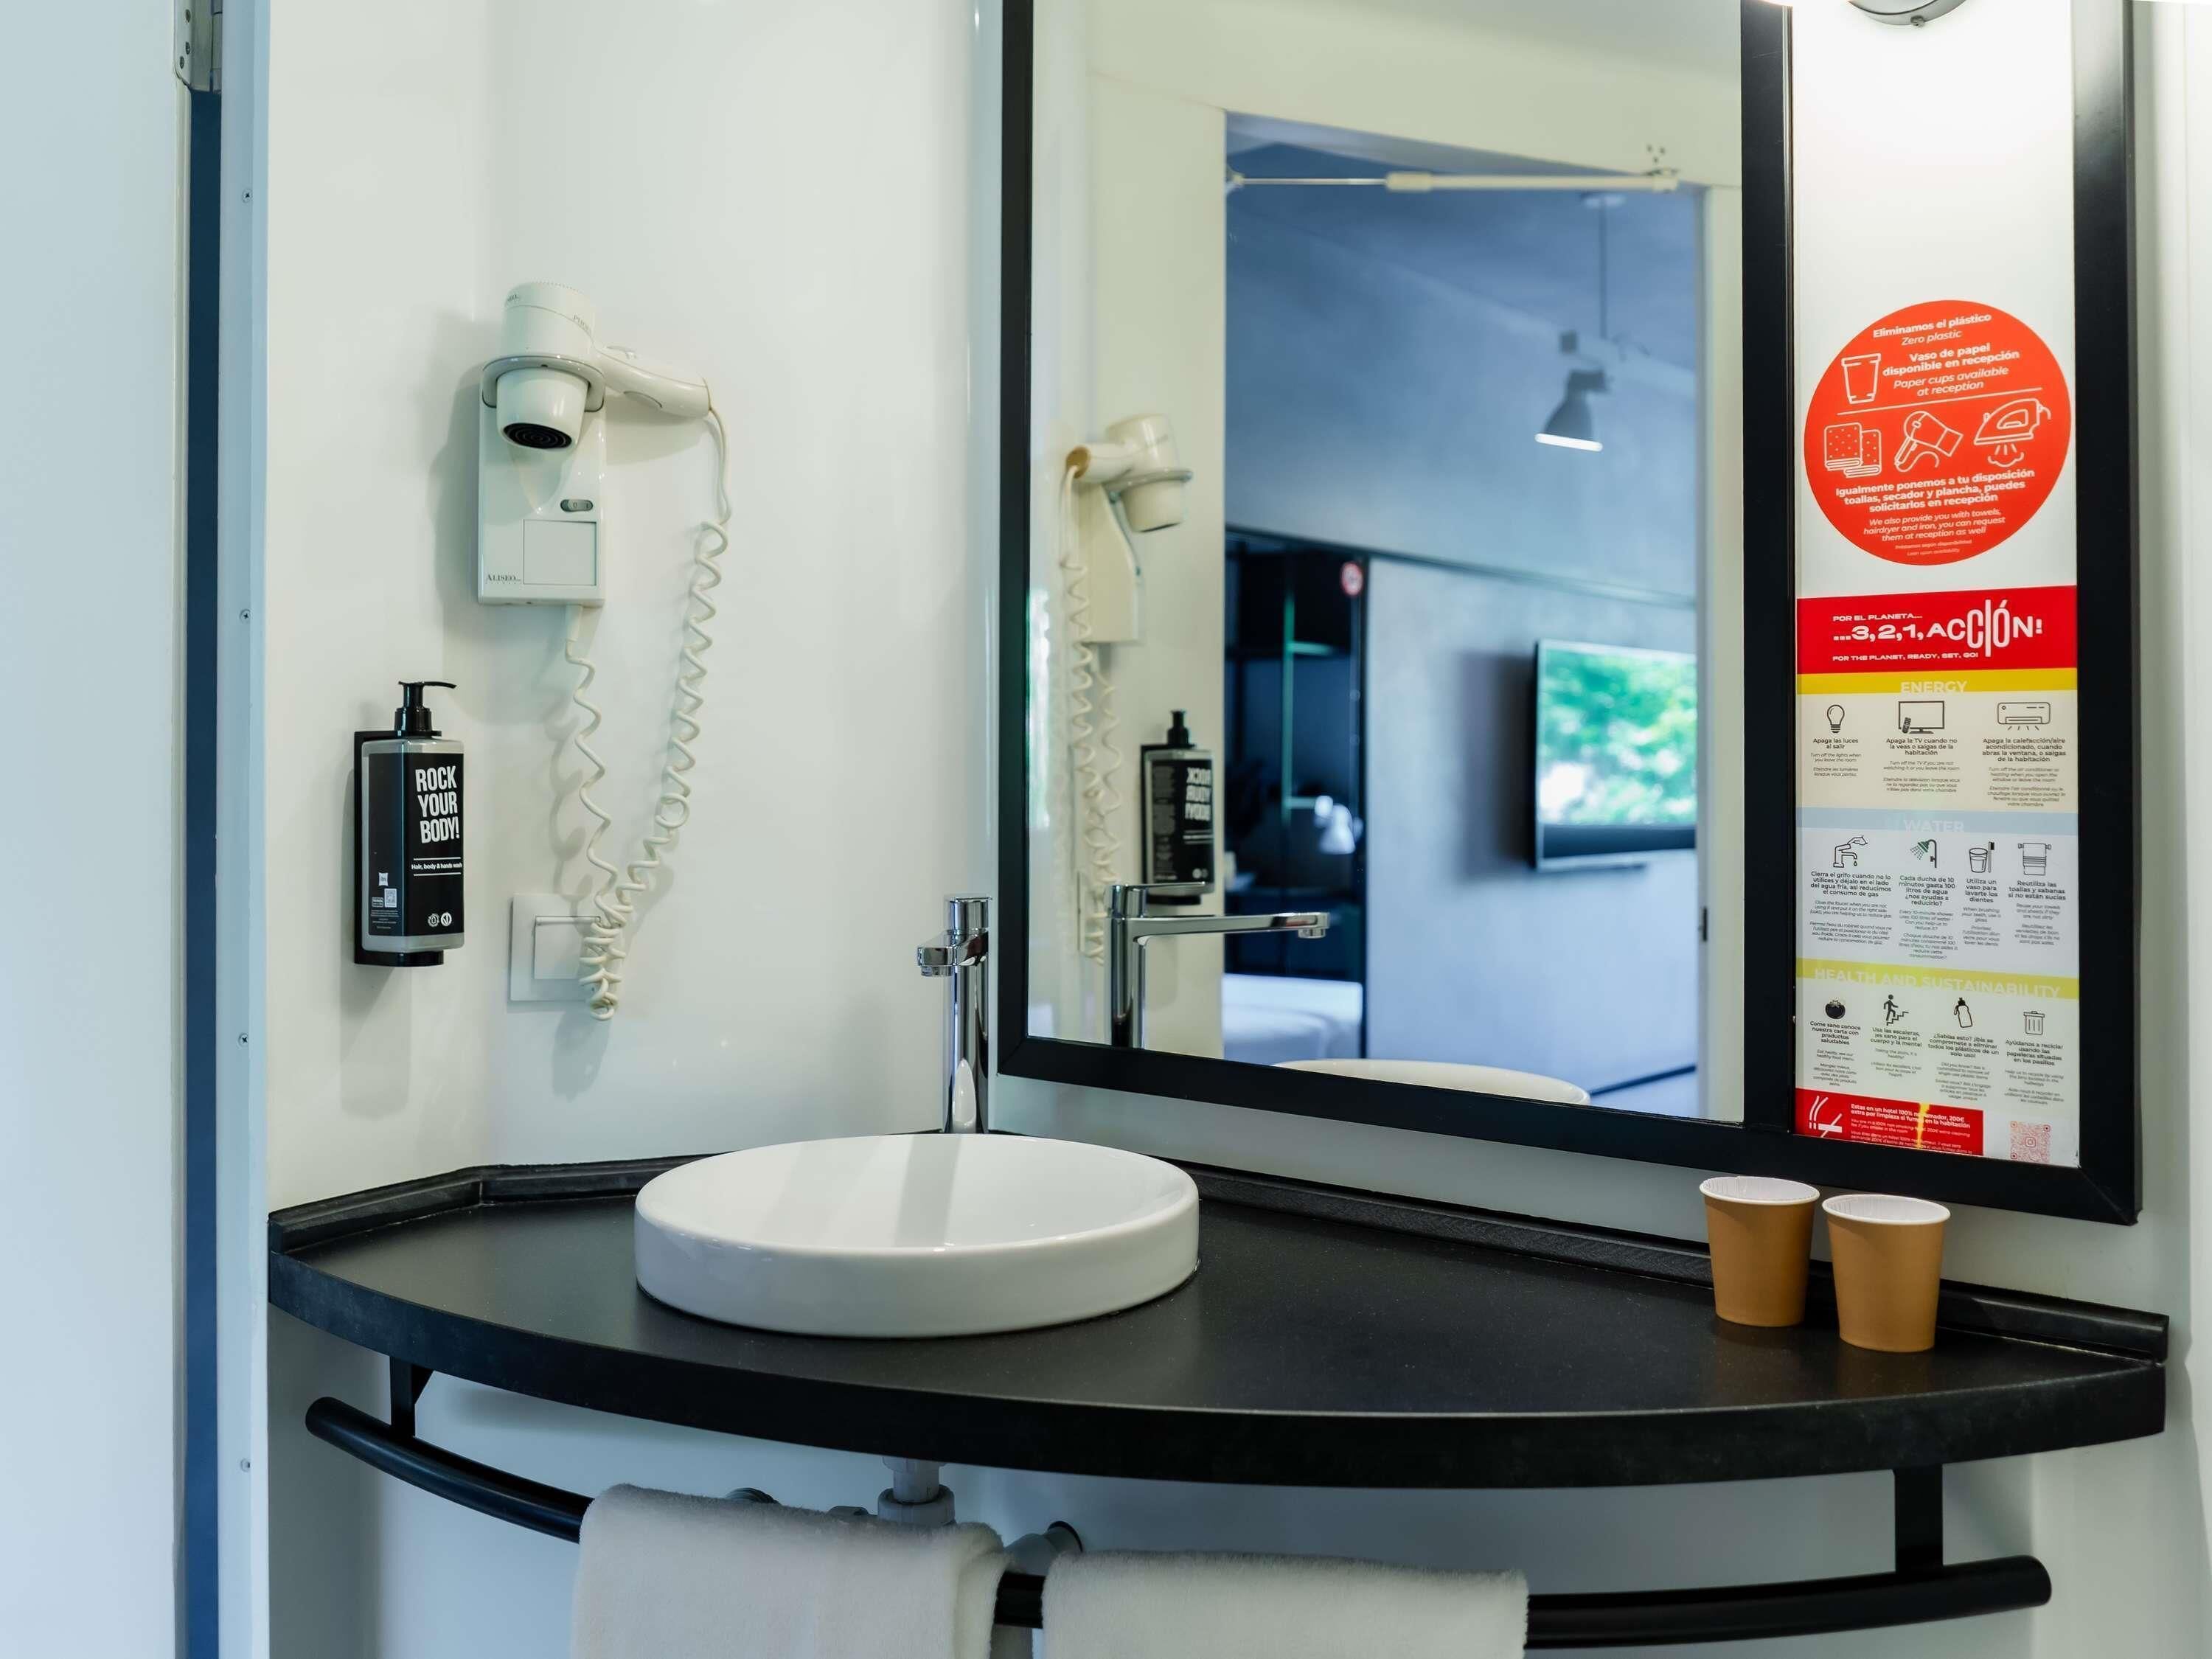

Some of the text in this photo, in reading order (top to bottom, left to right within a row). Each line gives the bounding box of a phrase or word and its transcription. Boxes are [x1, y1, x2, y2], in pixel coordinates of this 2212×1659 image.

[1874, 315, 1992, 337] Eliminamos el plástico
[1902, 330, 1962, 345] Zero plastic
[1909, 344, 1990, 362] Vaso de papel
[1882, 361, 1941, 376] disponible
[1962, 351, 2020, 365] recepción
[1893, 367, 2008, 389] Paper cups available
[1917, 381, 1983, 396] at reception
[1836, 483, 1893, 497] Igualmente
[1897, 479, 1946, 492] ponemos
[1957, 476, 1969, 484] tu
[1972, 470, 2034, 483] disposición
[1845, 481, 2025, 504] toallas, secador y plancha, puedes
[1870, 501, 1925, 512] solicitarlos
[1944, 494, 1997, 506] recepción
[1864, 526, 1899, 534] hairdryer
[1902, 523, 1917, 531] and
[1919, 522, 1936, 530] iron,
[1938, 522, 1954, 530] you
[1973, 515, 2006, 526] request
[1902, 514, 1932, 525] provide
[1935, 514, 1950, 522] you
[1952, 510, 1969, 518] with
[1972, 509, 2000, 517] towels,
[1882, 533, 1903, 541] them
[1916, 529, 1954, 539] reception
[1969, 526, 1986, 534] well
[1900, 681, 1968, 694] ENERGY
[415, 765, 457, 792] ROCK
[417, 791, 458, 817] YOUR
[420, 817, 460, 844] BODY!
[1904, 820, 1964, 832] WATER
[1815, 967, 2061, 997] HEALTH AND SUSTAINABILITY
[1877, 1111, 1899, 1119] limpieza
[1940, 1119, 1970, 1128] habitación
